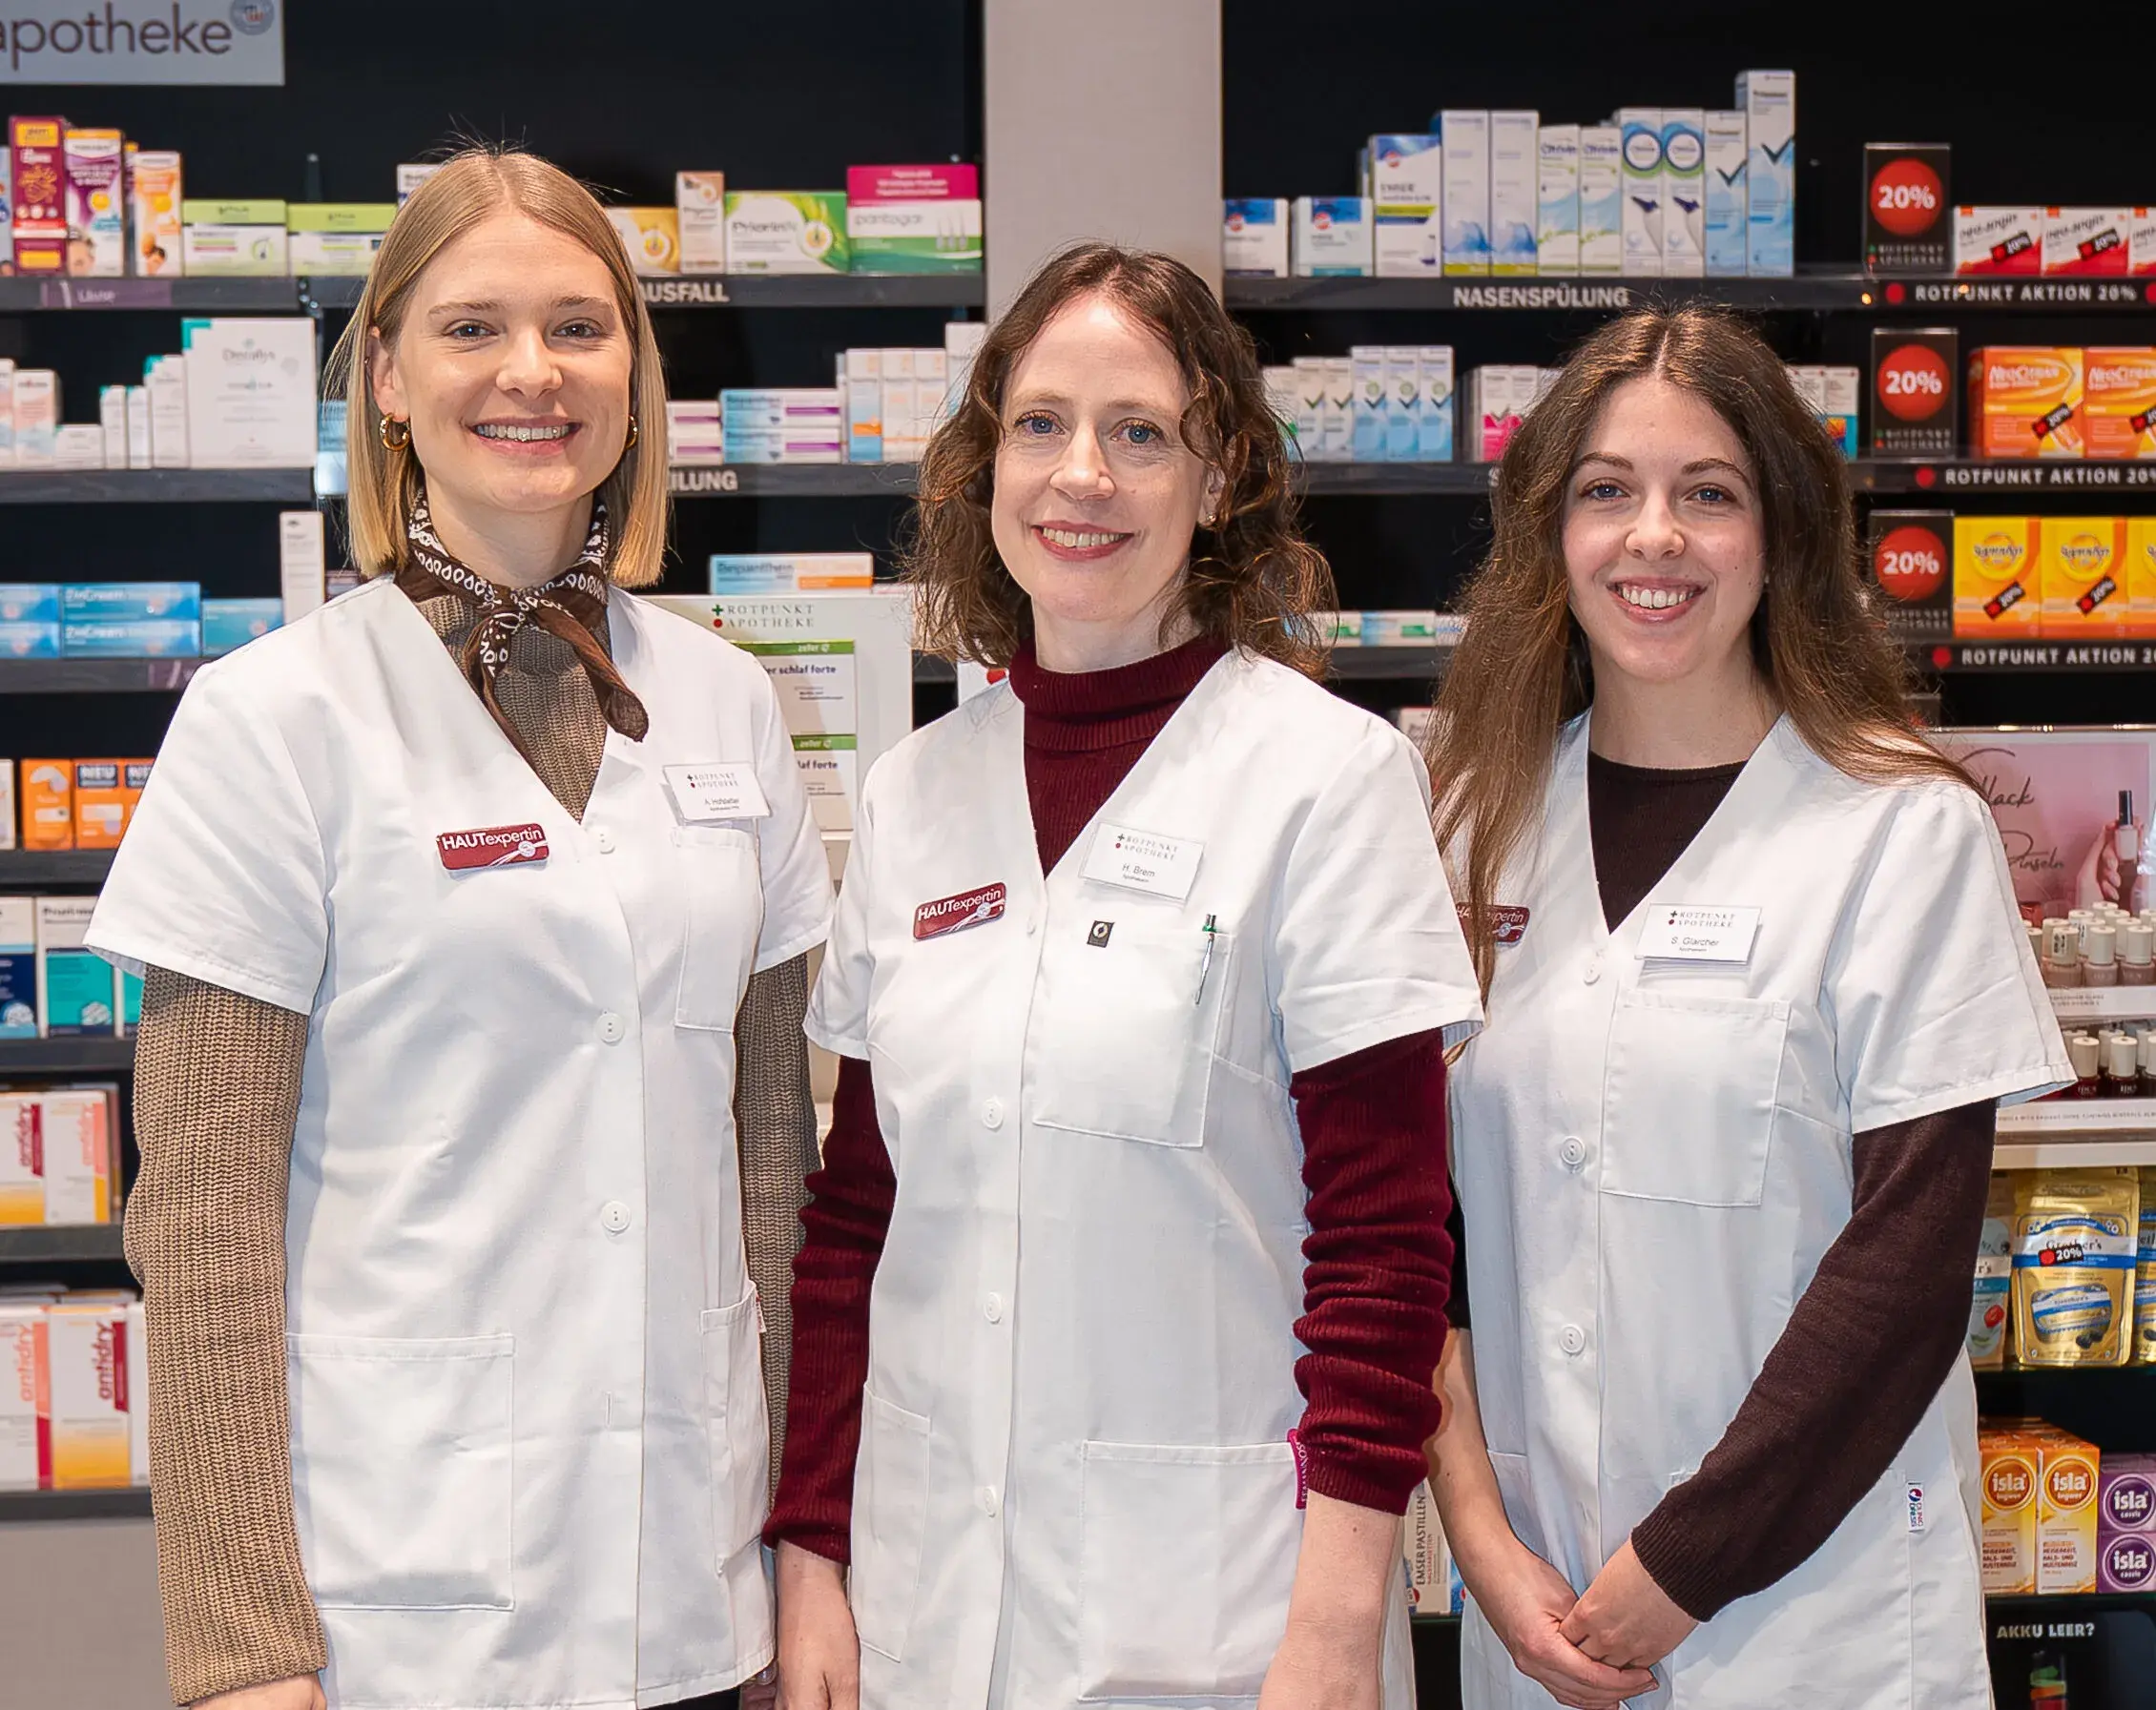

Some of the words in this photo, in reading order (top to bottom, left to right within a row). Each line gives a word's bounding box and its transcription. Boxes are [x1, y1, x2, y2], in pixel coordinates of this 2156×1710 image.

[0, 2, 232, 71] potheke
[1877, 185, 1936, 209] 20%
[1453, 283, 1628, 308] NASENSPÜLUNG
[1915, 284, 2013, 301] ROTPUNKT
[2021, 284, 2091, 301] AKTION
[2098, 284, 2137, 301] 20%
[1885, 370, 1942, 395] 20%
[670, 469, 738, 491] ILUNG
[1945, 467, 2042, 485] ROTPUNKT
[2050, 467, 2121, 484] AKTION
[1883, 551, 1939, 575] 20%
[727, 605, 814, 615] ROTPUNKT
[727, 618, 814, 628] APOTHEKE
[1961, 649, 2060, 665] ROTPUNKT
[2066, 648, 2136, 665] AKTION
[778, 665, 809, 674] schlaf
[811, 665, 837, 674] forte
[813, 760, 838, 769] forte
[441, 827, 543, 851] HAUTexpertin
[1134, 866, 1155, 877] Brem
[918, 888, 1002, 921] HAUTexpertin
[1457, 905, 1524, 924] HApertin
[2056, 1246, 2082, 1261] 20%
[1992, 1473, 2025, 1493] isla
[2053, 1472, 2086, 1492] isla
[2114, 1491, 2147, 1511] isla
[1416, 1495, 1426, 1550] PASTILLEN
[1416, 1552, 1426, 1585] EMSER
[2114, 1550, 2147, 1570] isla
[1997, 1624, 2043, 1638] AKKU
[2048, 1623, 2095, 1638] LEER?
